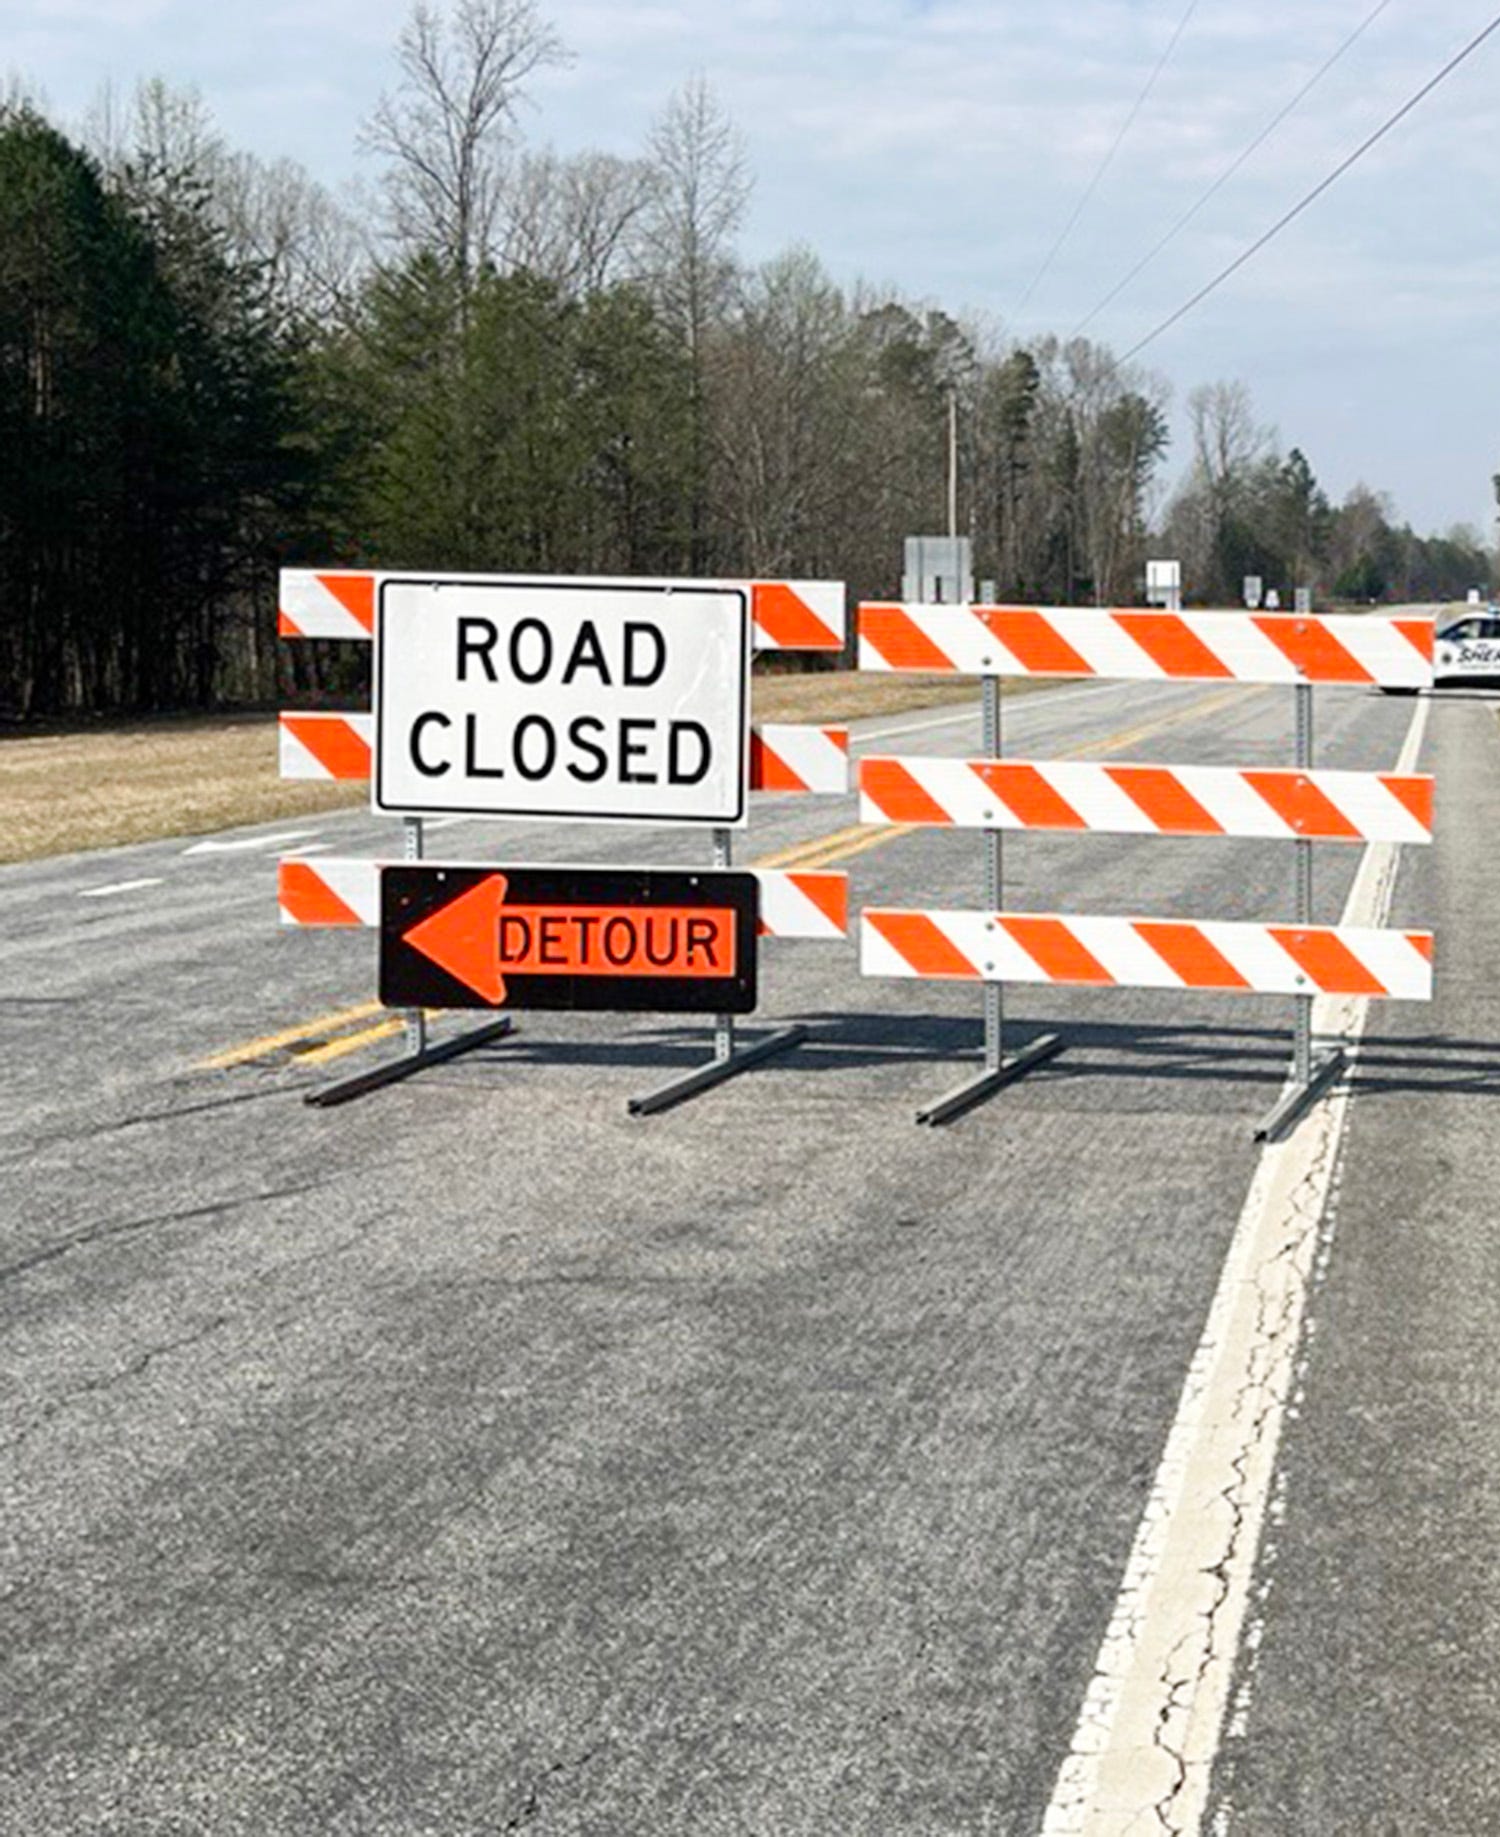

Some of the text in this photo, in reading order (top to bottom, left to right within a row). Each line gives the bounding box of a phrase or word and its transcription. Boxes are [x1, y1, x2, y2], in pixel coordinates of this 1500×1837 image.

[456, 617, 667, 687] ROAD
[408, 710, 713, 786] CLOSED
[499, 915, 720, 968] DETOUR
